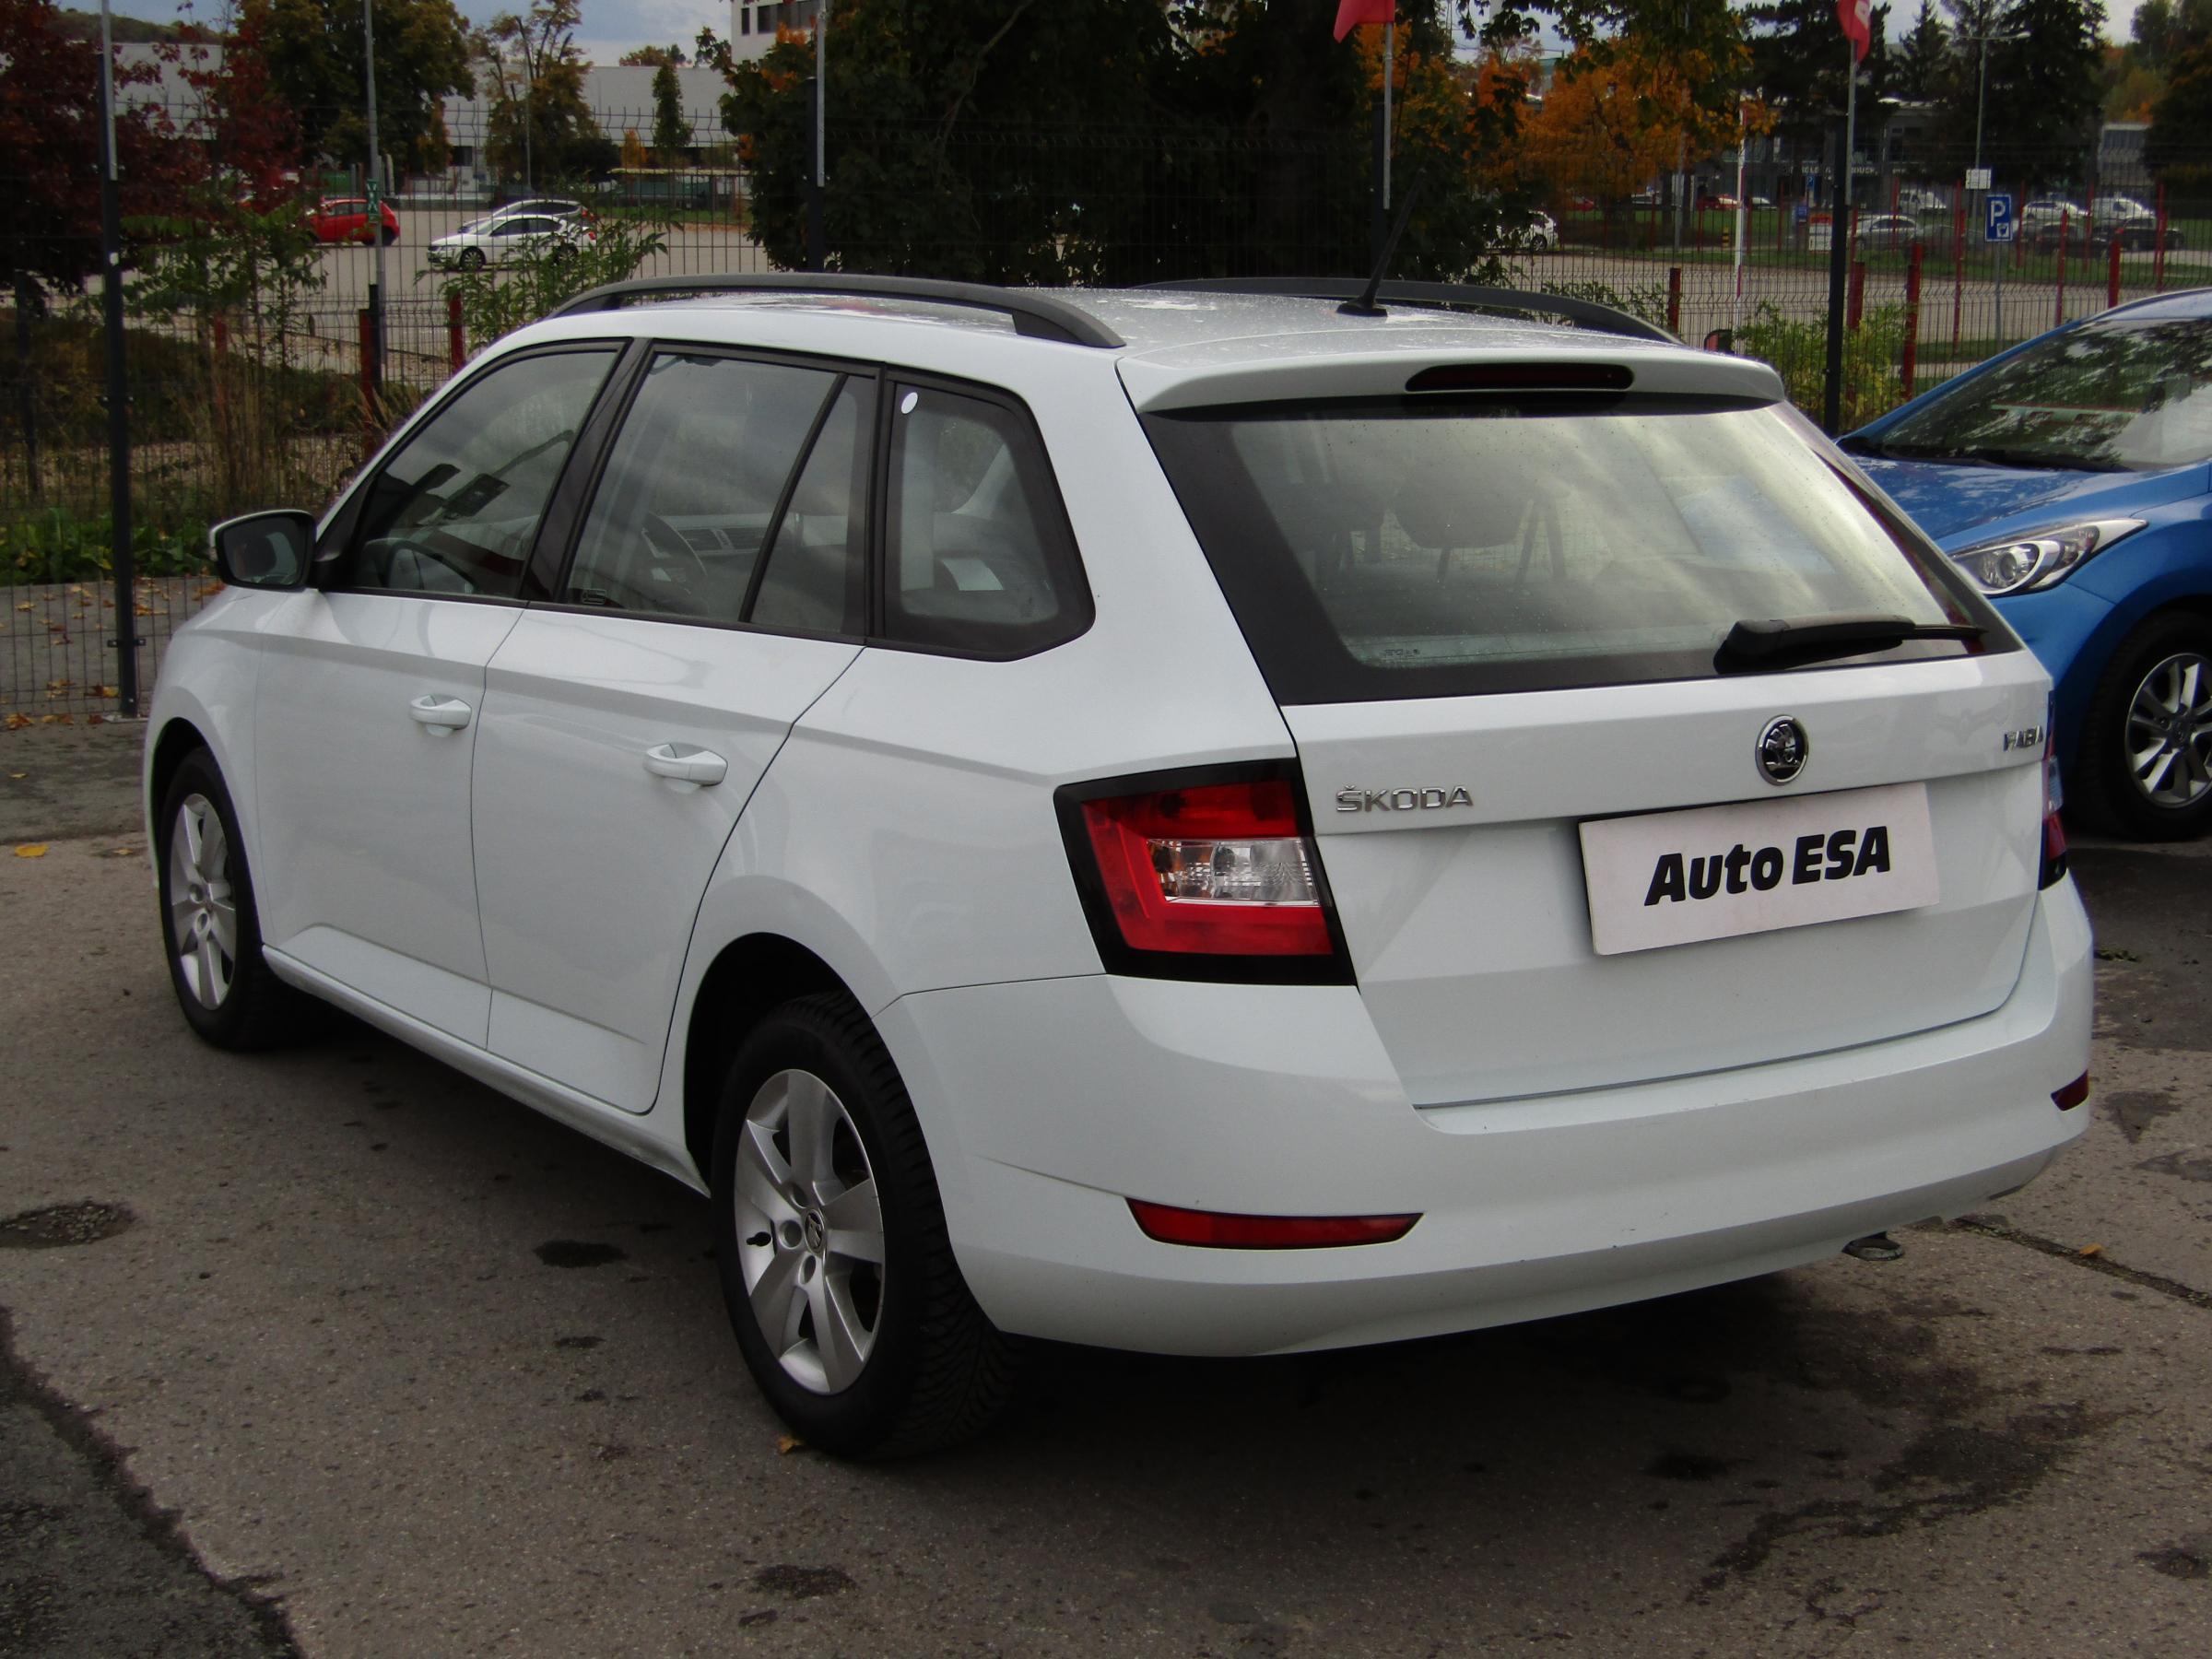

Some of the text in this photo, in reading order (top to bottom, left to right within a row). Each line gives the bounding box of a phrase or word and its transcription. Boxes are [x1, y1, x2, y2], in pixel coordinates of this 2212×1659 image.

[1991, 200, 2006, 227] P
[1335, 784, 1474, 813] ŠKODA
[1644, 826, 1890, 906] Auto ESA
